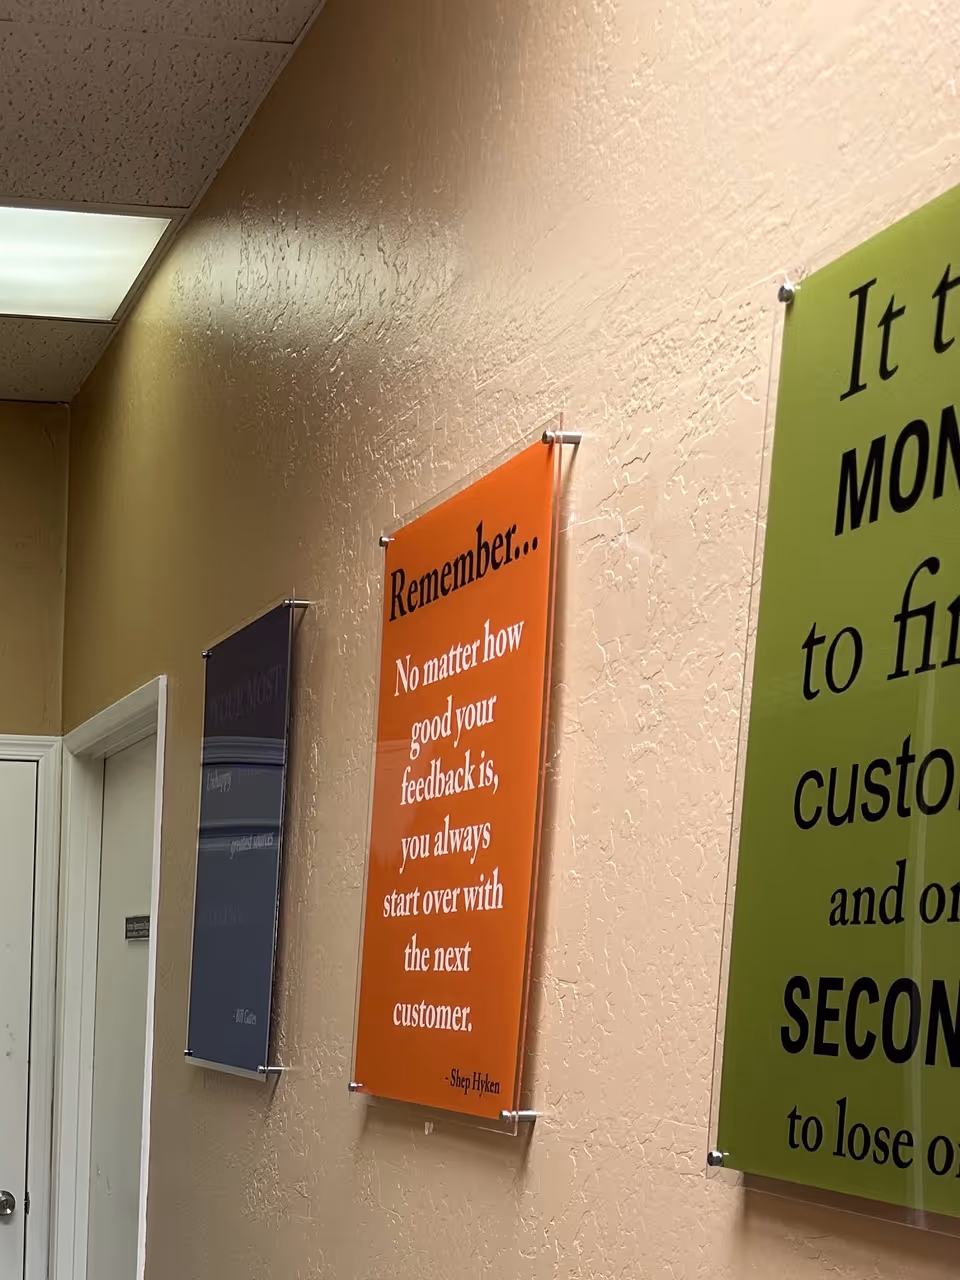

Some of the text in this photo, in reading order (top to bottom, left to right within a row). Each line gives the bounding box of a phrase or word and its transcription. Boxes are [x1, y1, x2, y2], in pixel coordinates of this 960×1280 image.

[840, 277, 906, 401] It
[389, 520, 538, 622] Remember...
[394, 618, 525, 697] No matter how
[801, 621, 863, 700] to
[409, 694, 497, 760] good your
[400, 749, 499, 806] feedback is,
[794, 734, 960, 830] custo
[399, 814, 491, 874] you always
[383, 866, 504, 918] start over with
[829, 858, 907, 926] and
[404, 932, 471, 973] the next
[392, 999, 473, 1032] customer.
[780, 975, 960, 1068] SECON
[472, 1071, 500, 1097] Hyken
[787, 1105, 823, 1152] to
[833, 1096, 914, 1170] lose
